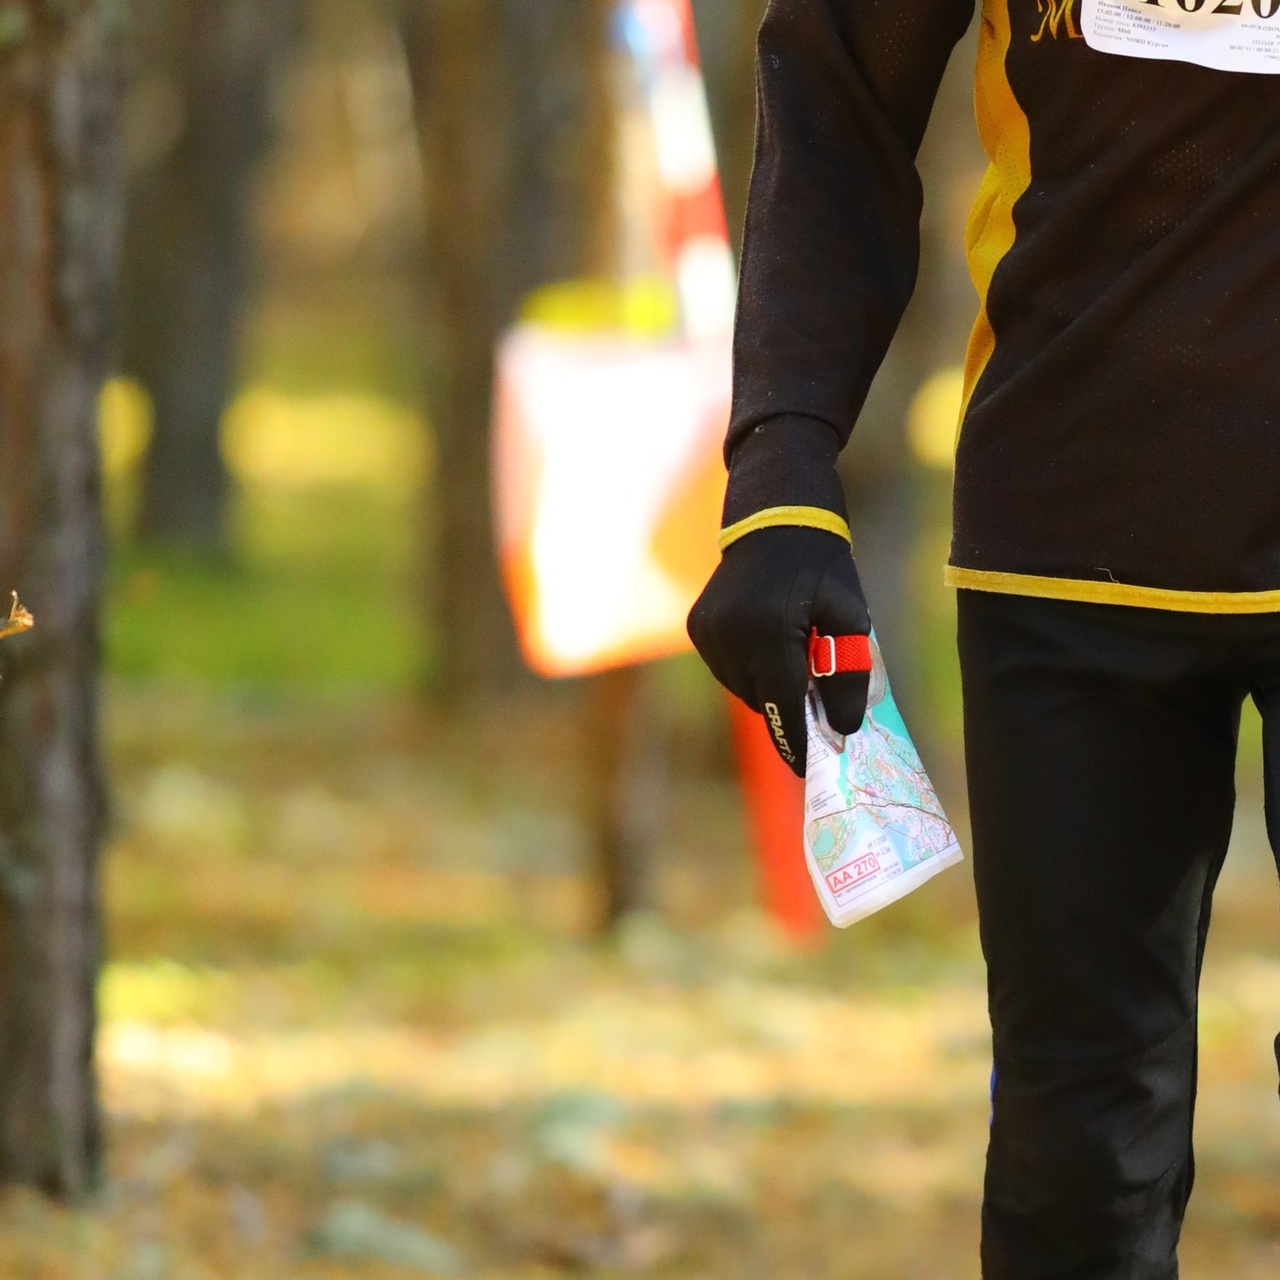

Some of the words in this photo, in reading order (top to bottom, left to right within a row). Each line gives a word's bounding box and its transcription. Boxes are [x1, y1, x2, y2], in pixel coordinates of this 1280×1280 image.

[765, 702, 792, 754] CRAFT
[833, 871, 853, 888] AA
[854, 857, 876, 876] 270
